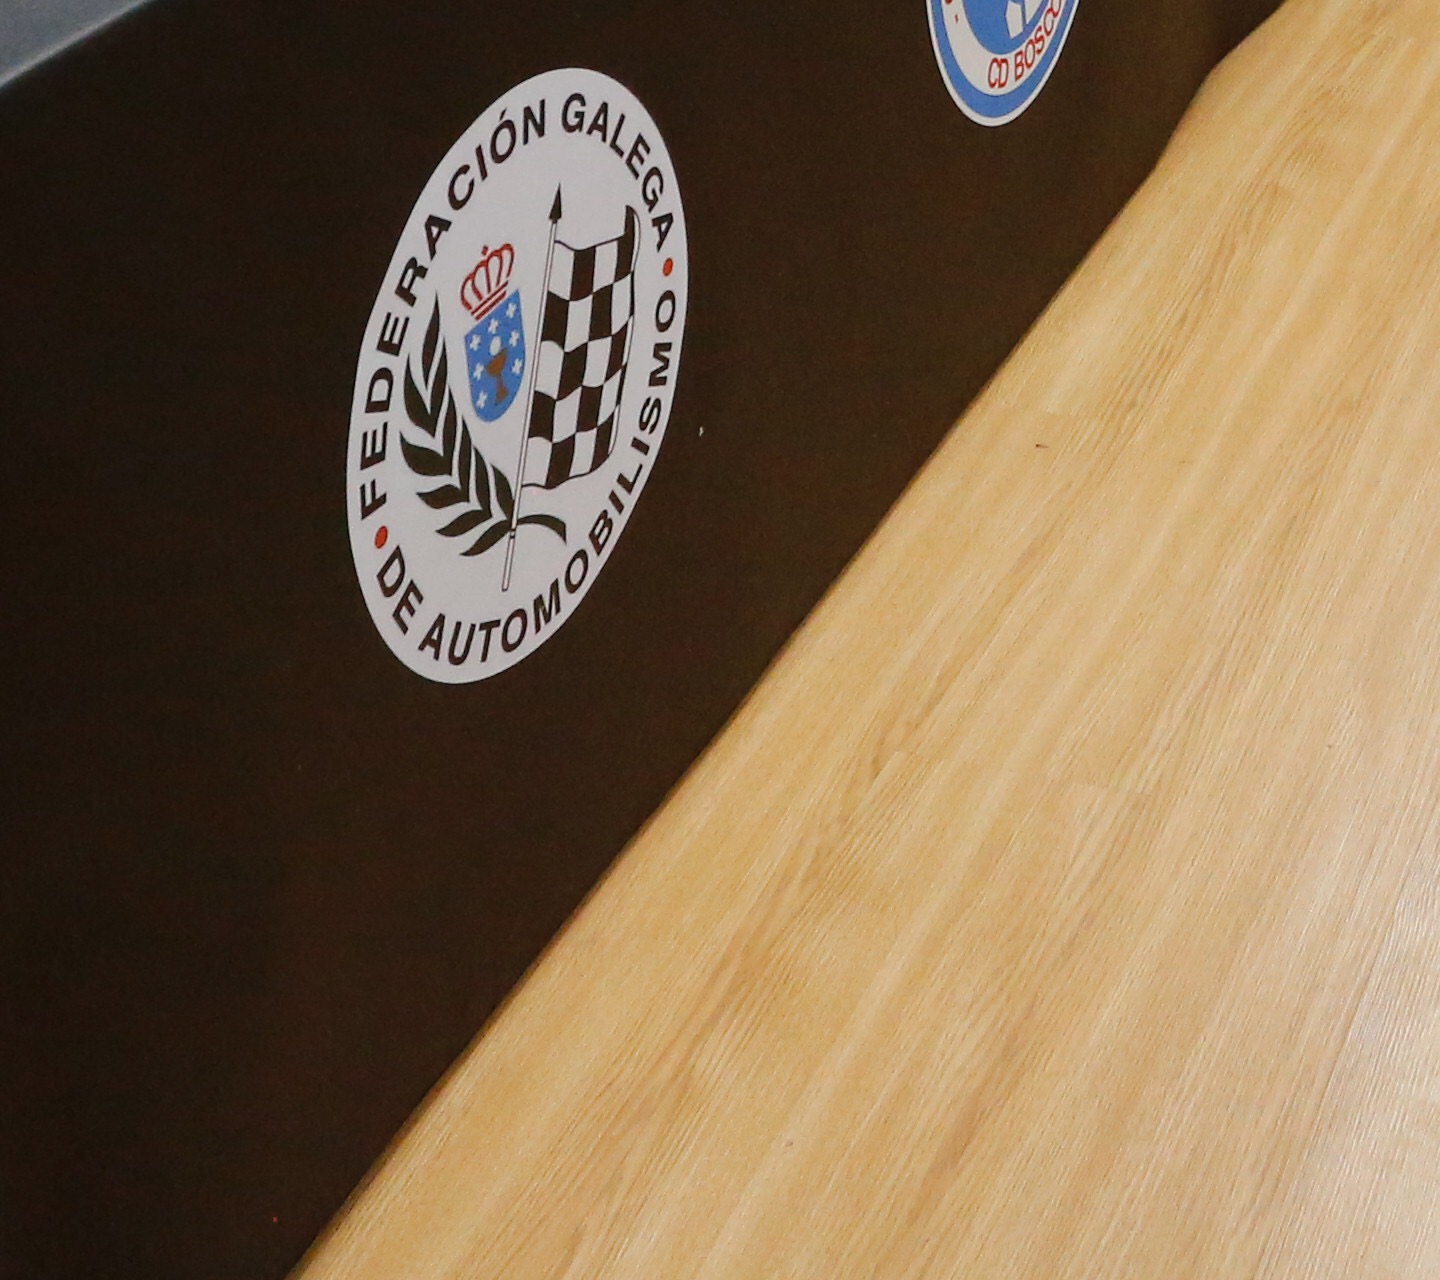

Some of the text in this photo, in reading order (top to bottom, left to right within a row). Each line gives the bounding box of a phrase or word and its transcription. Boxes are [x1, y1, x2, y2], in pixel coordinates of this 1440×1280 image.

[987, 55, 1009, 90] CD
[359, 92, 675, 521] FEDERACIÓN GALEGA
[375, 288, 677, 667] DE AUTOMOBILISMO
